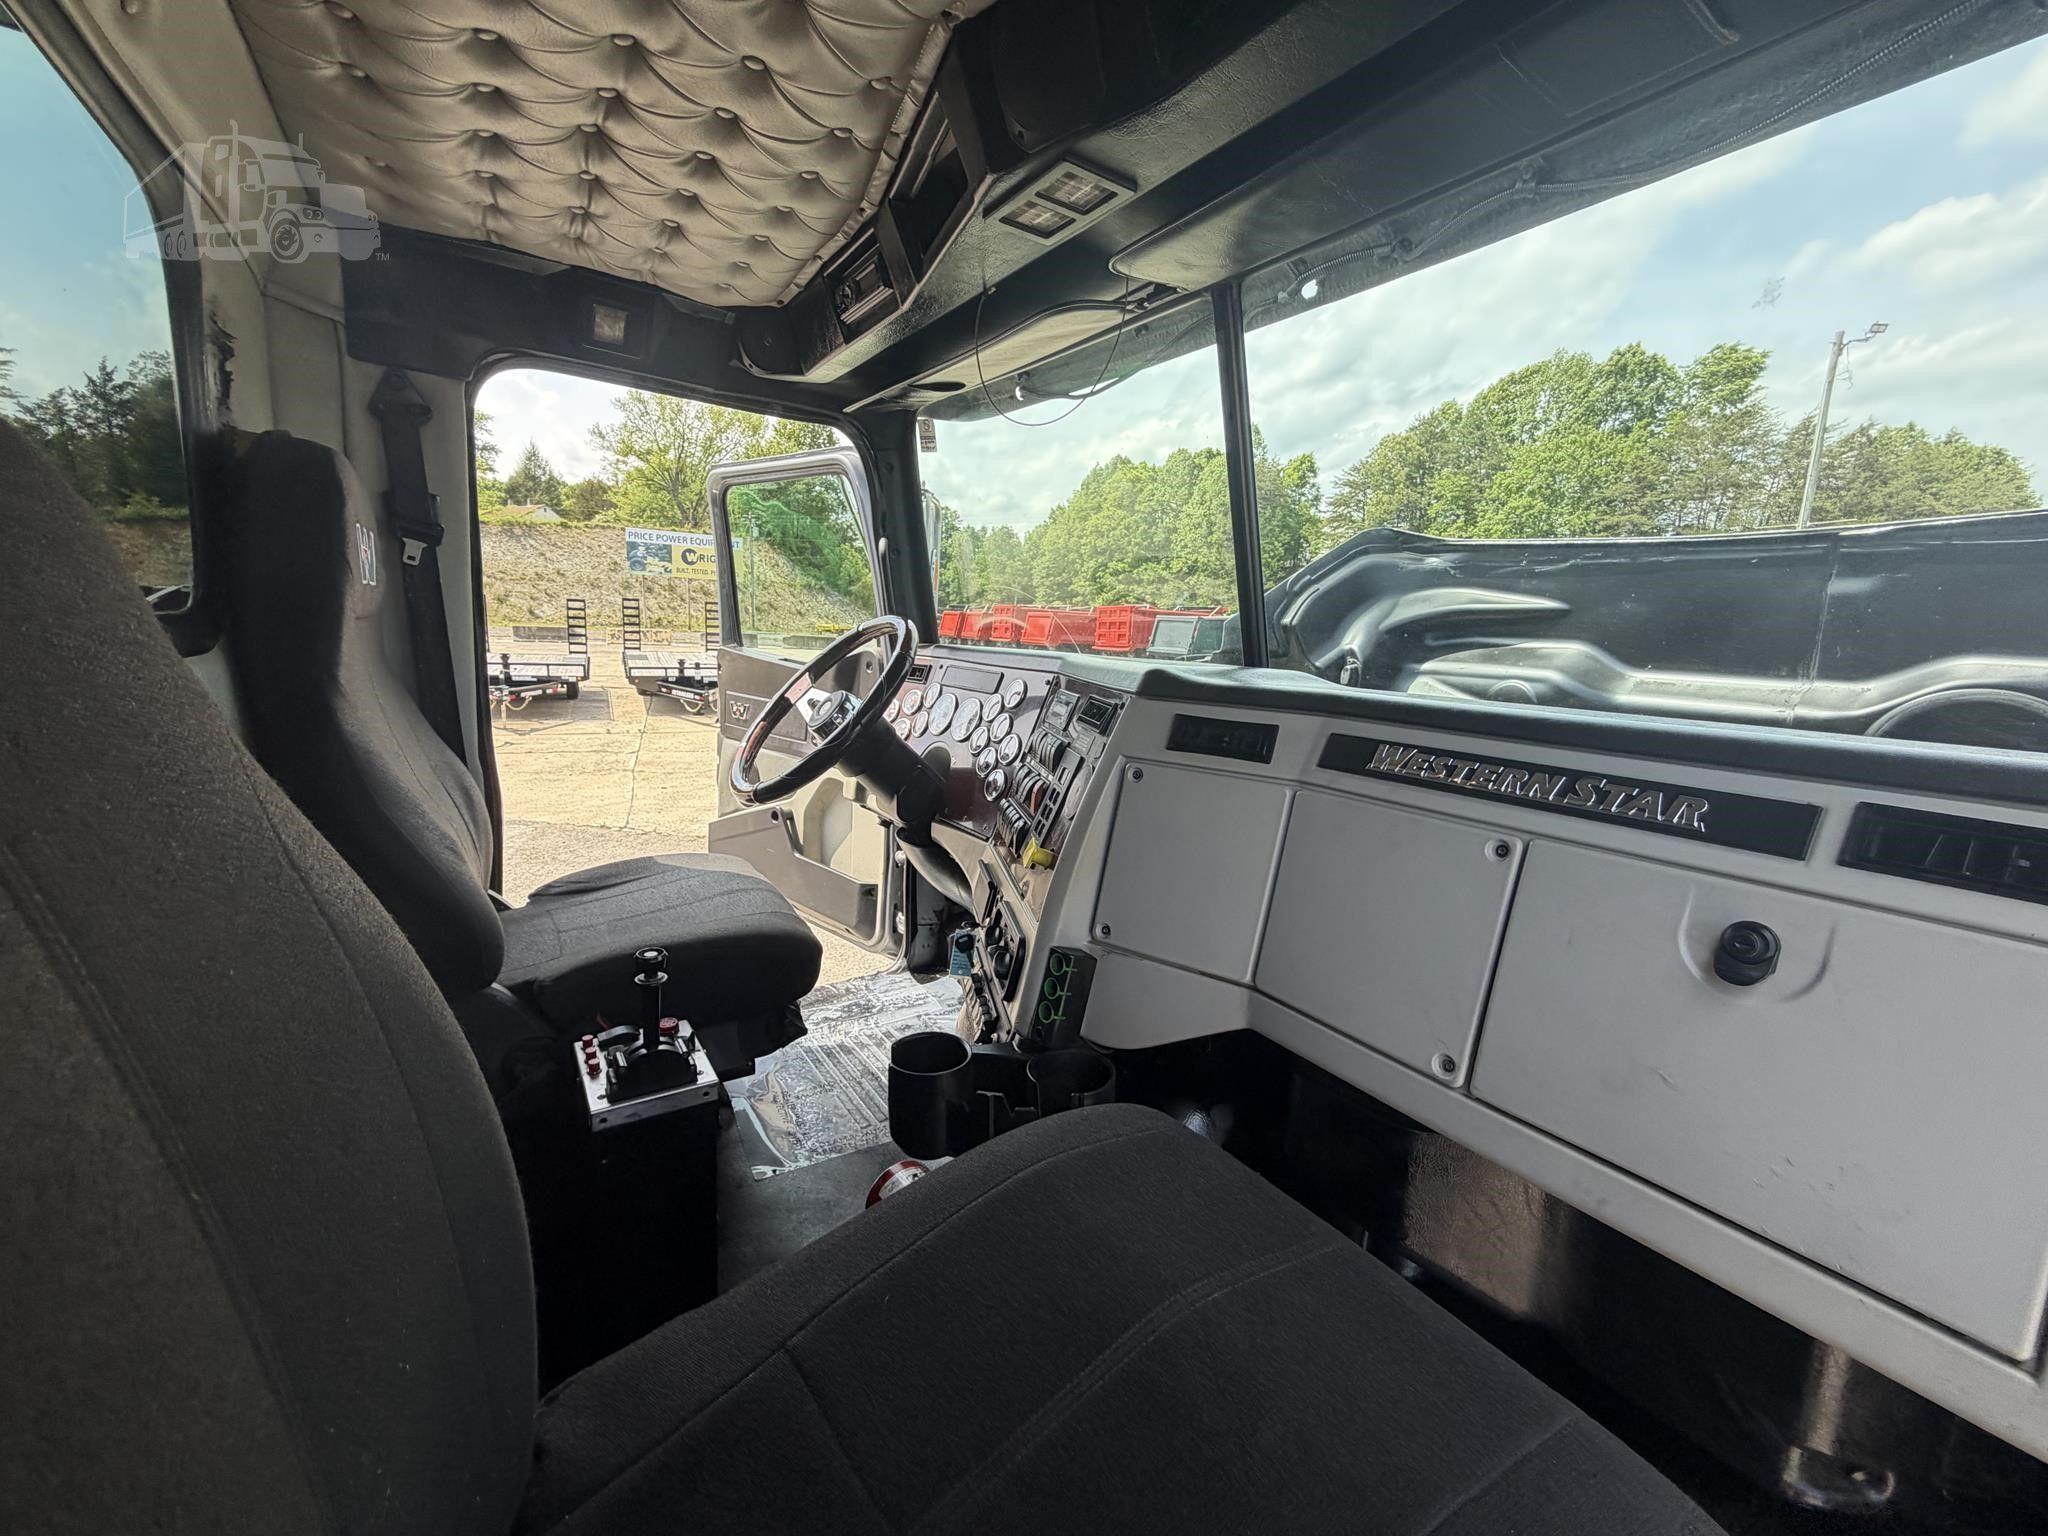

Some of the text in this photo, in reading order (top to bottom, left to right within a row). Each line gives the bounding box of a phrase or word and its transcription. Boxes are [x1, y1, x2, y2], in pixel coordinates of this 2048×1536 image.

[628, 531, 654, 541] PRICE
[656, 534, 688, 544] POWER
[681, 548, 716, 566] WRIG
[1366, 743, 1710, 832] WESTERN STAR
